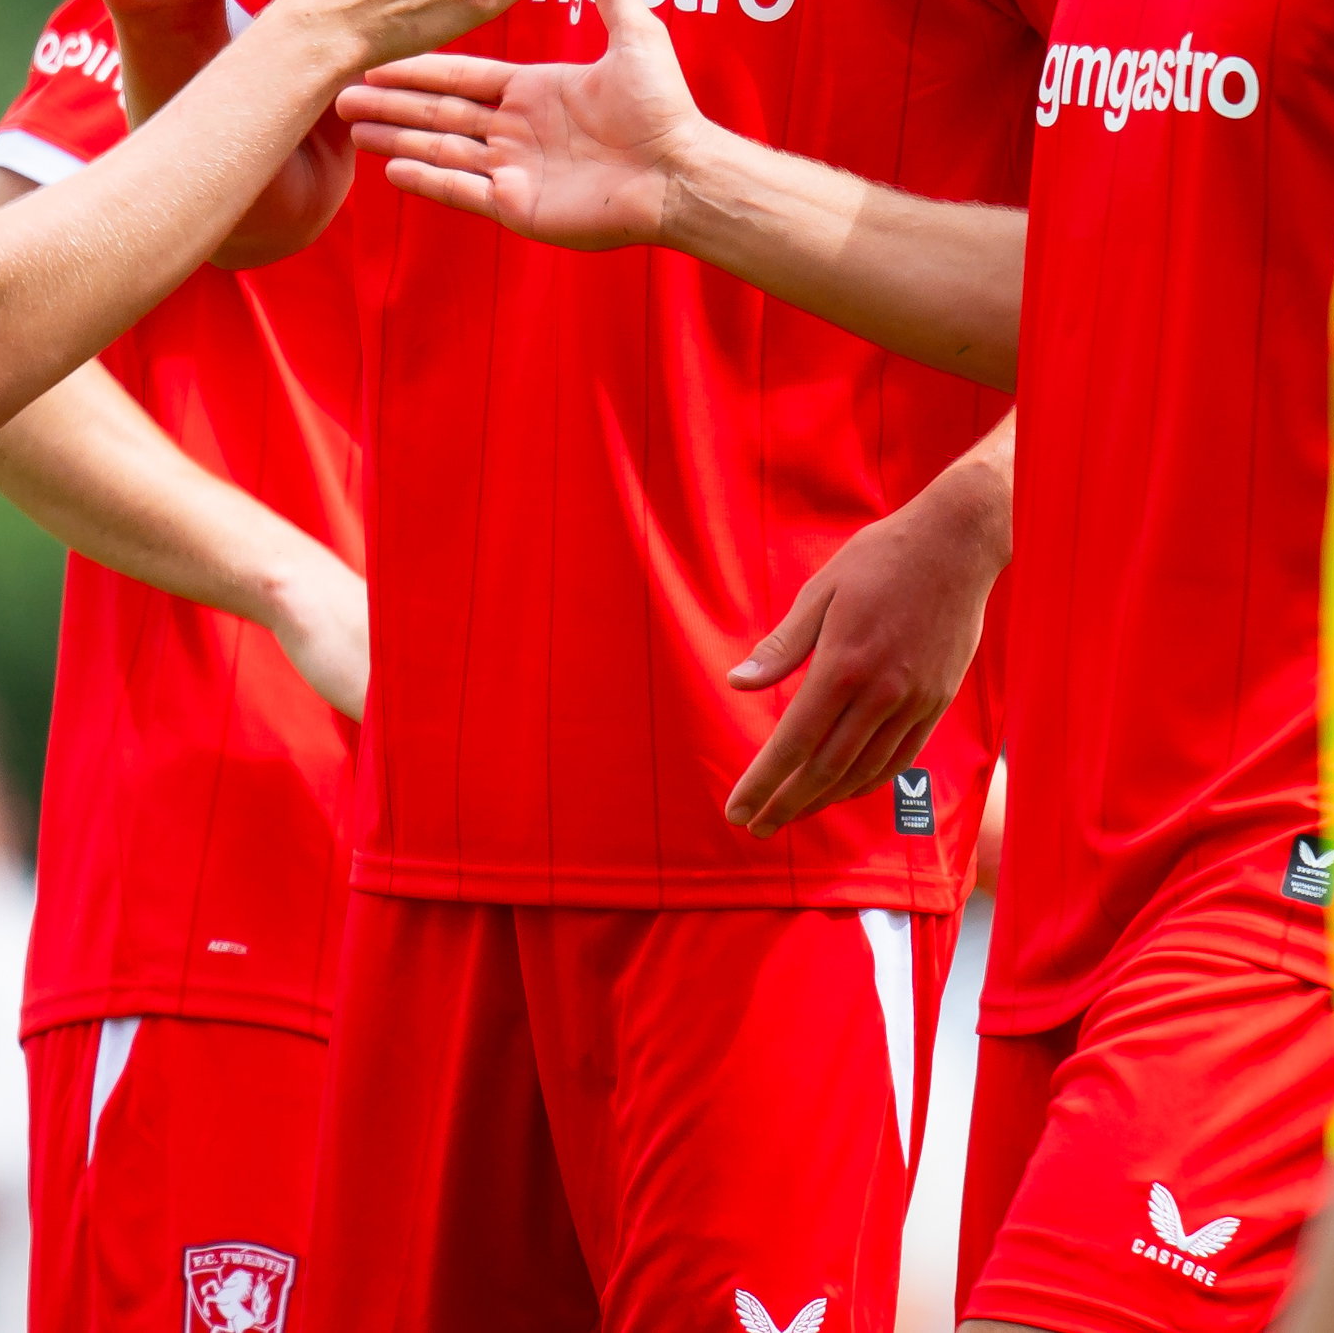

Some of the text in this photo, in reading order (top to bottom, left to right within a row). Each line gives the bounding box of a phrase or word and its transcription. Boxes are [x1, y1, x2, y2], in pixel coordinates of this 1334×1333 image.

[1036, 32, 1260, 133] gmgastro
[220, 1253, 286, 1274] TWENTE
[1131, 1238, 1218, 1287] CASTORE
